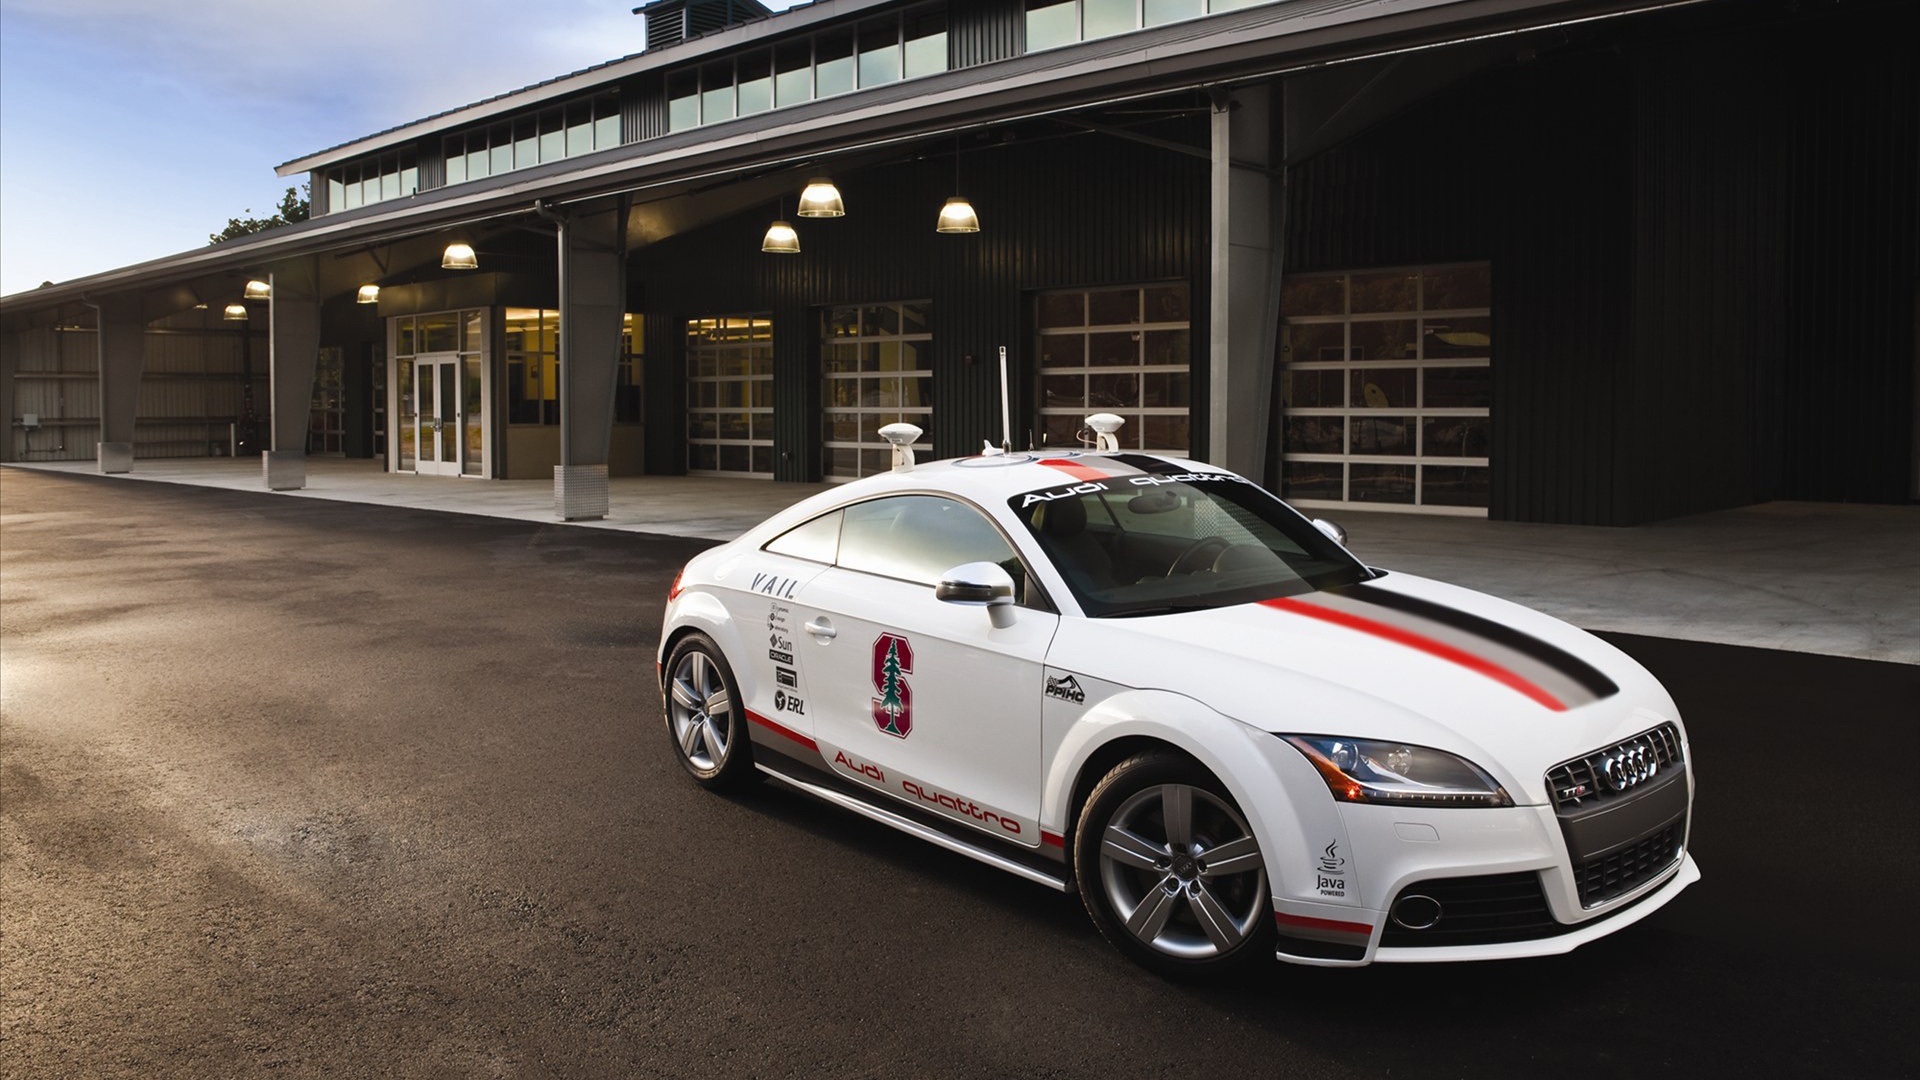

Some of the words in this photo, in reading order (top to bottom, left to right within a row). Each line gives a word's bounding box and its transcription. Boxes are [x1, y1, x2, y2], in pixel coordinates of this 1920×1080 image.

[1022, 482, 1109, 508] Audi
[1129, 473, 1249, 486] quattro
[751, 572, 798, 600] VAIL
[777, 636, 793, 652] Sun
[770, 651, 793, 664] ORACLE
[1045, 684, 1086, 703] PPIHC
[786, 696, 805, 715] ERL
[834, 751, 886, 783] Audi
[902, 780, 1021, 834] quattro
[1316, 874, 1345, 890] Java
[1320, 889, 1345, 897] POWERED
